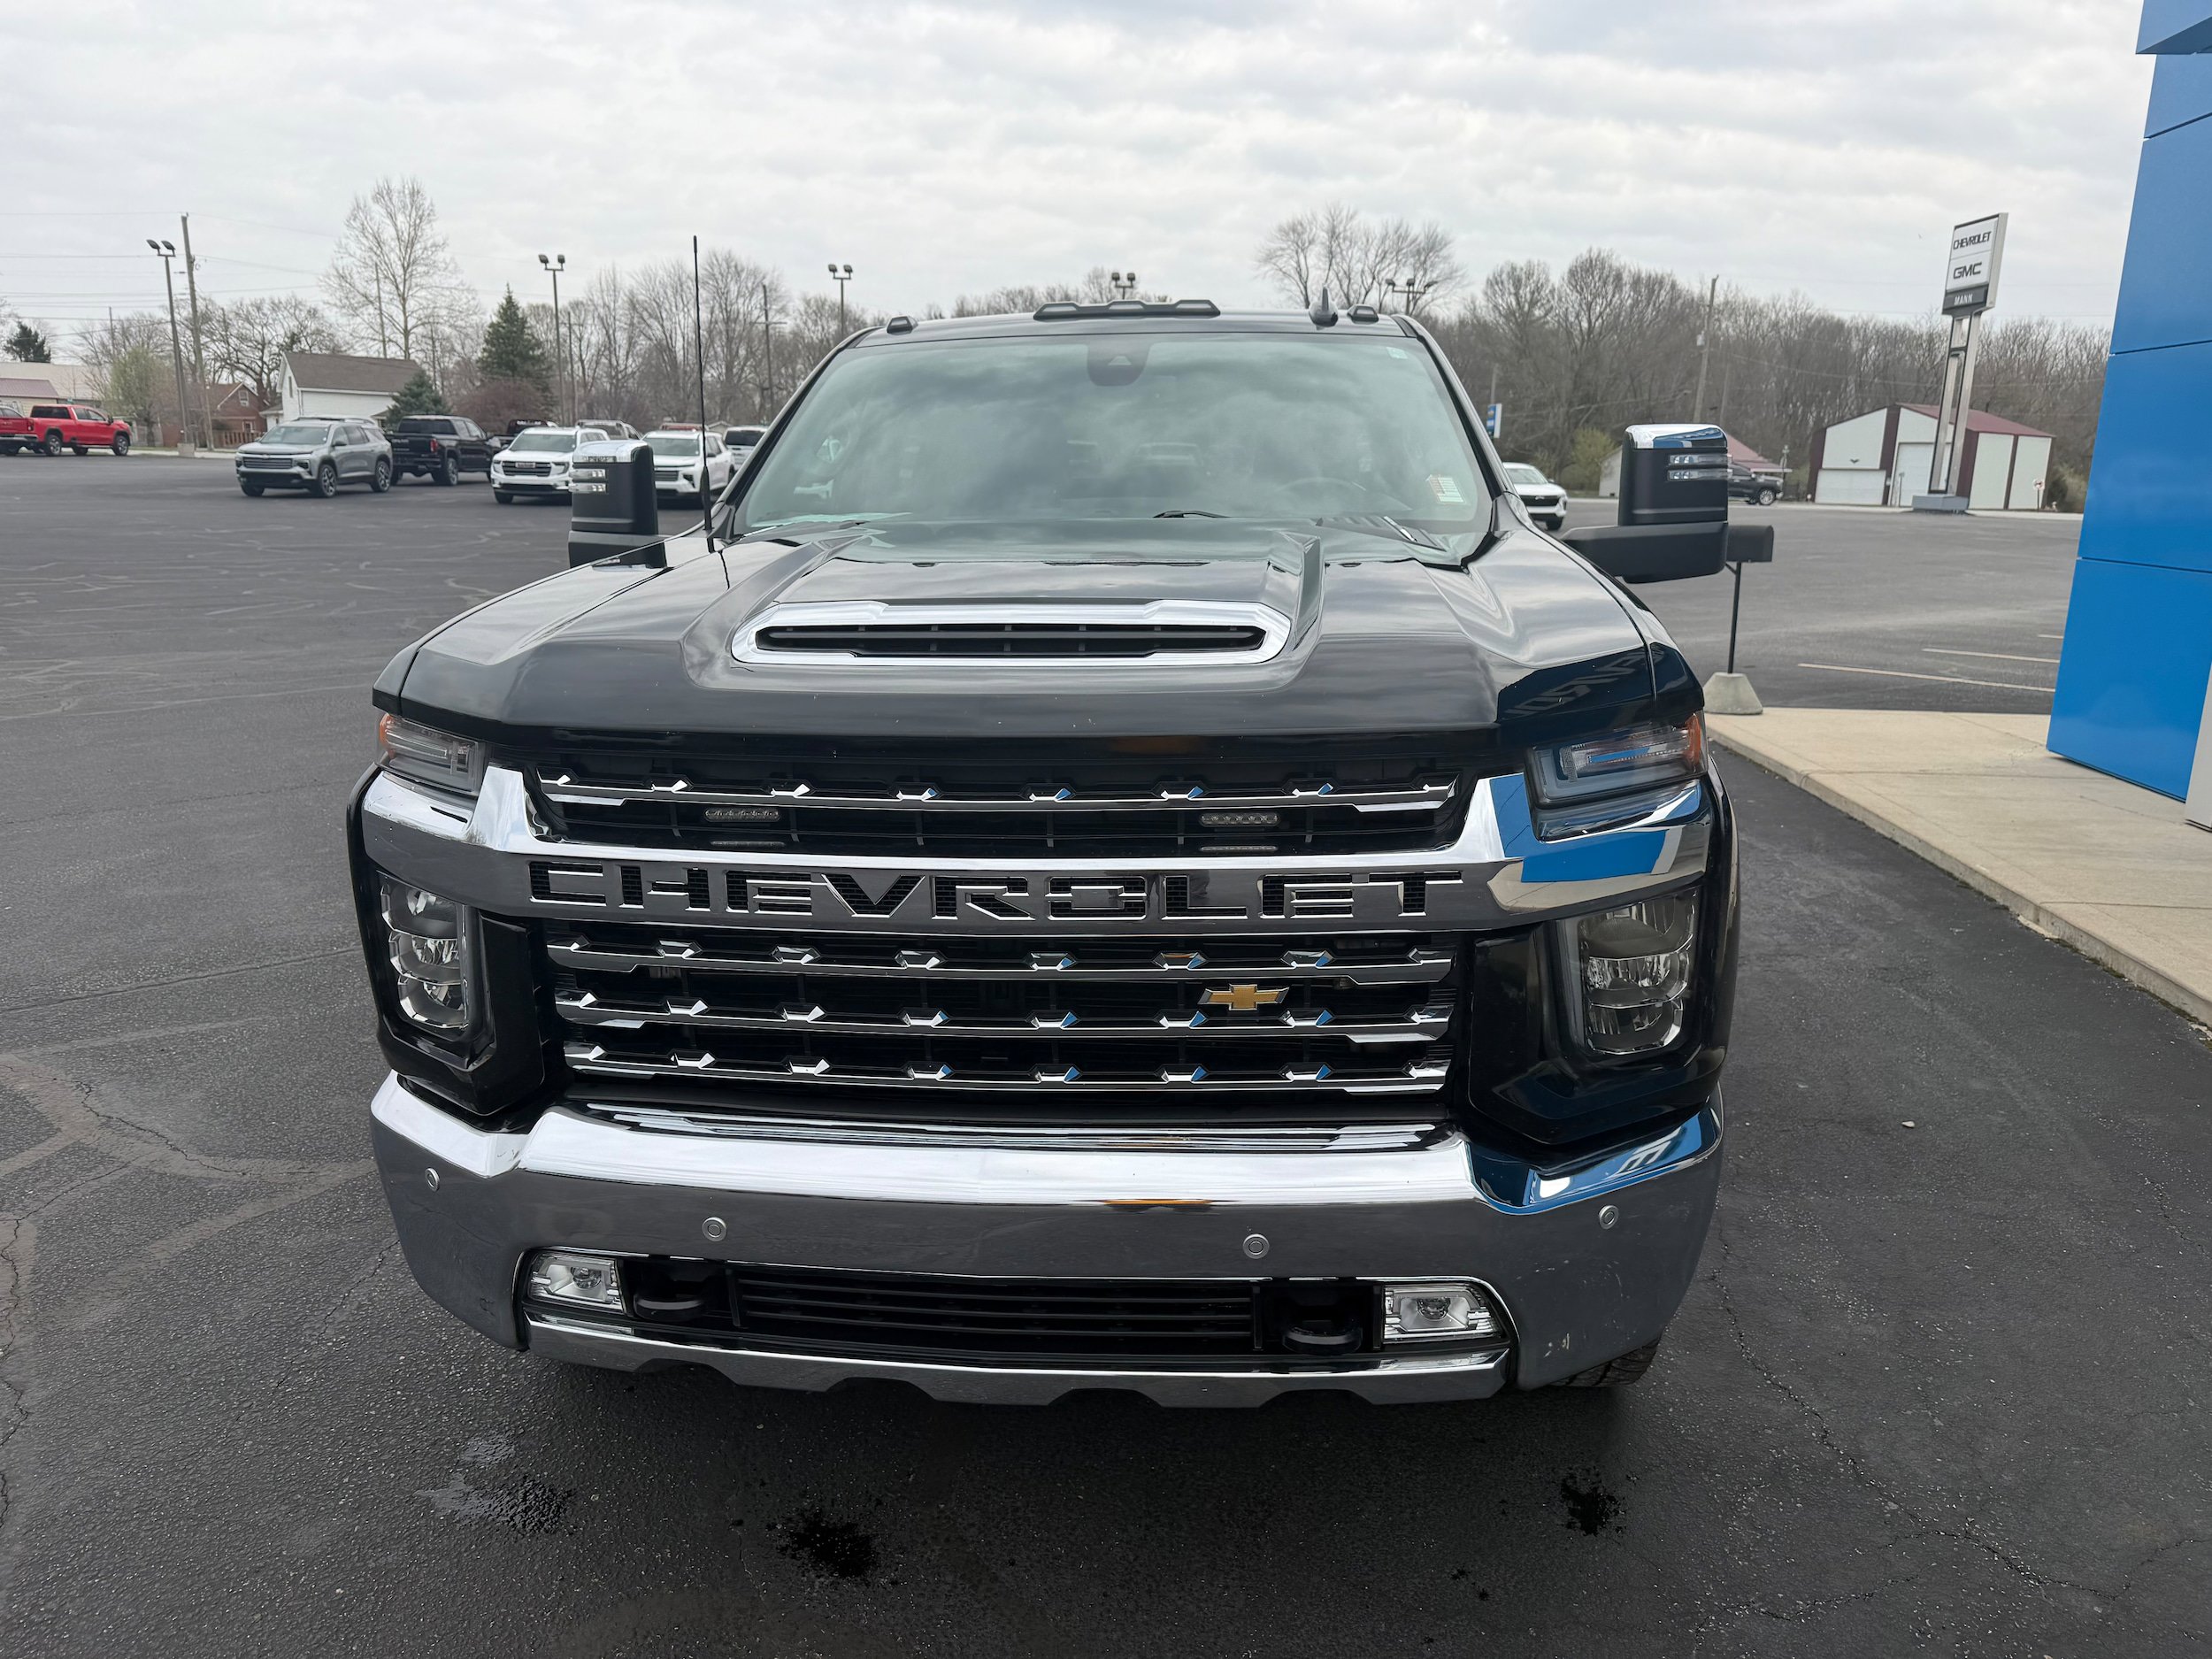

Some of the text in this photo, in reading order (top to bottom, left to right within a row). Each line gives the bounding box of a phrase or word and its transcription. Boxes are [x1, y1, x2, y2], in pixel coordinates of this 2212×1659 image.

[1954, 231, 1992, 250] CHEVROLET
[1953, 262, 1982, 280] GMC
[529, 859, 1463, 921] CHEVROLET
